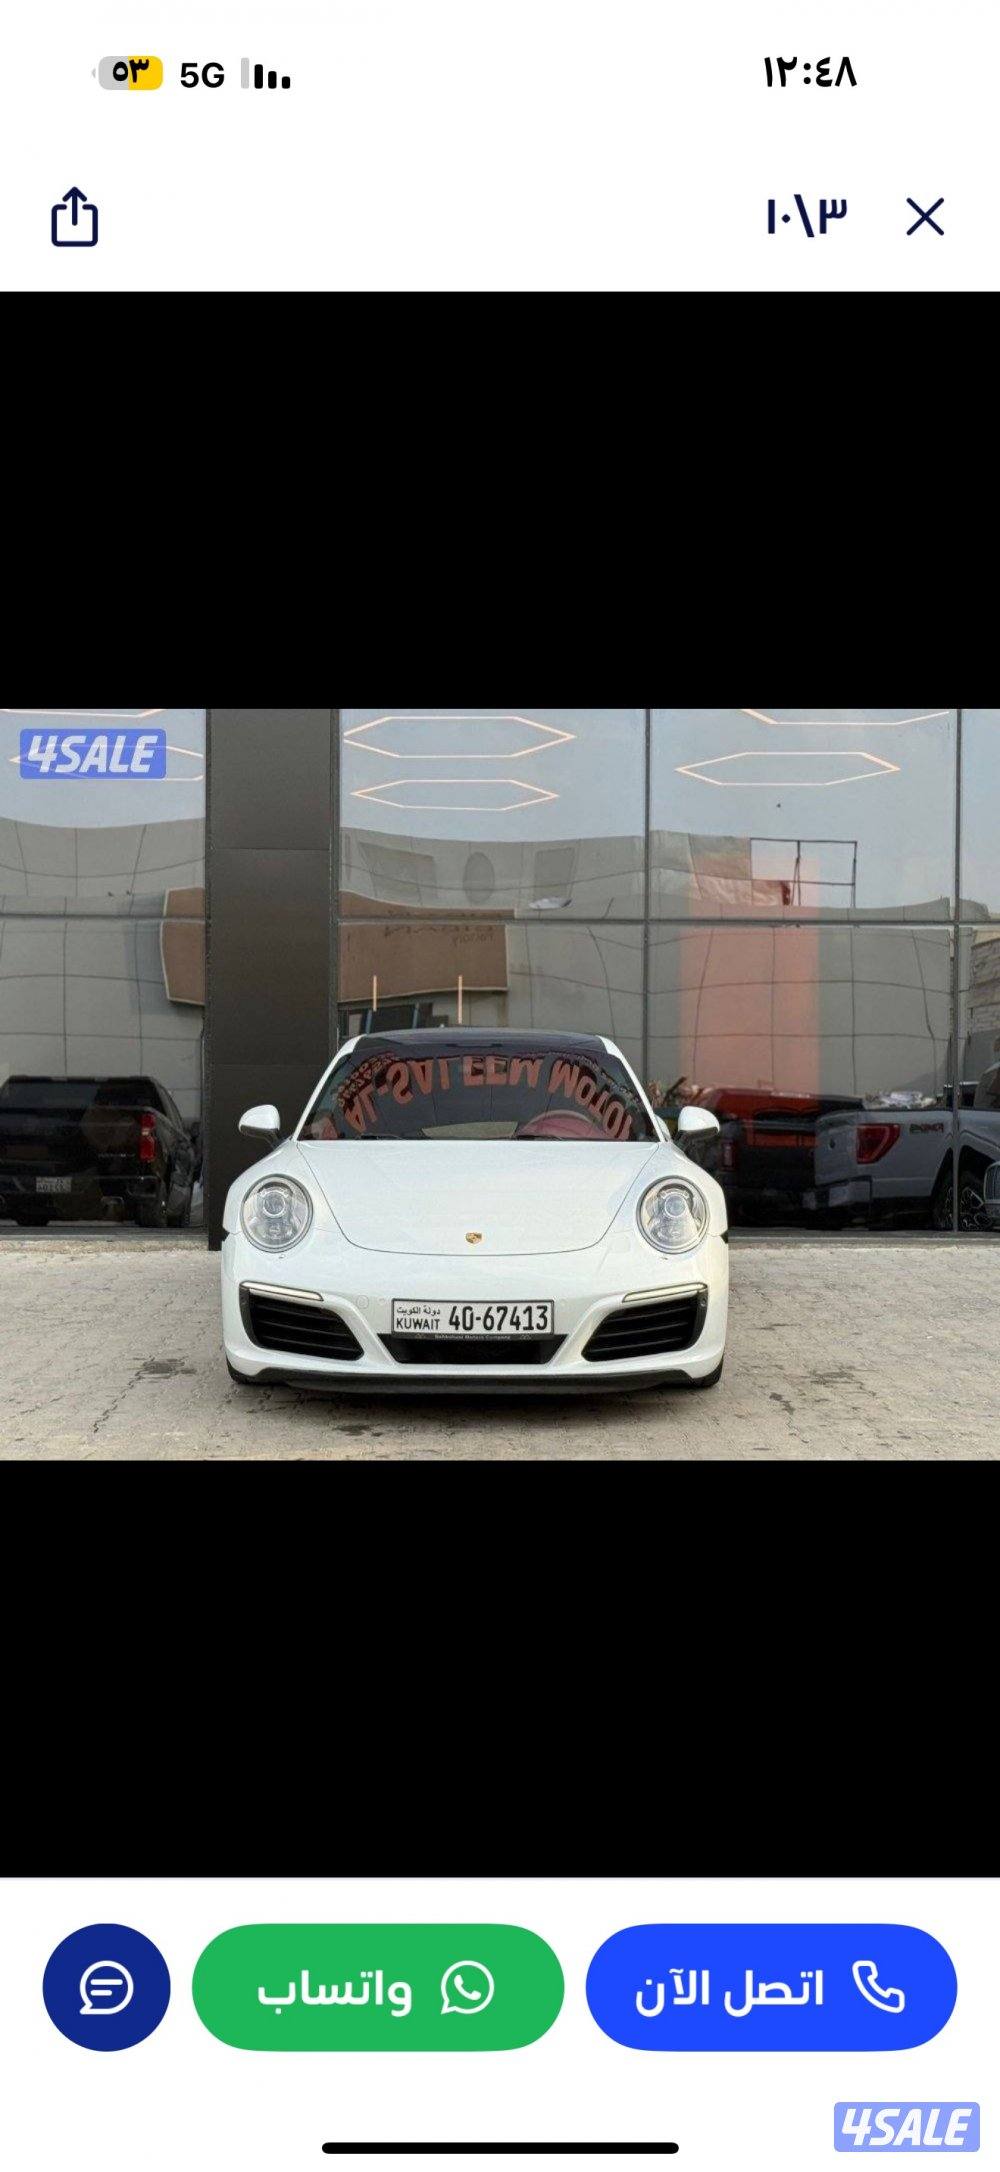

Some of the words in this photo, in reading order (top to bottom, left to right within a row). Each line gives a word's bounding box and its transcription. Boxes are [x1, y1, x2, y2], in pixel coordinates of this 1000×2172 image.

[112, 58, 150, 84] ٥٣
[180, 62, 225, 89] 5G
[764, 56, 858, 88] ١٢:٤٨
[396, 1317, 440, 1330] KUWAIT
[397, 1306, 421, 1317] الكويت
[423, 1304, 441, 1317] دولة
[449, 1305, 548, 1331] 40-67413
[258, 1969, 412, 2017] واتساب
[635, 1968, 710, 2018] الآن
[723, 1969, 824, 2018] اتصل
